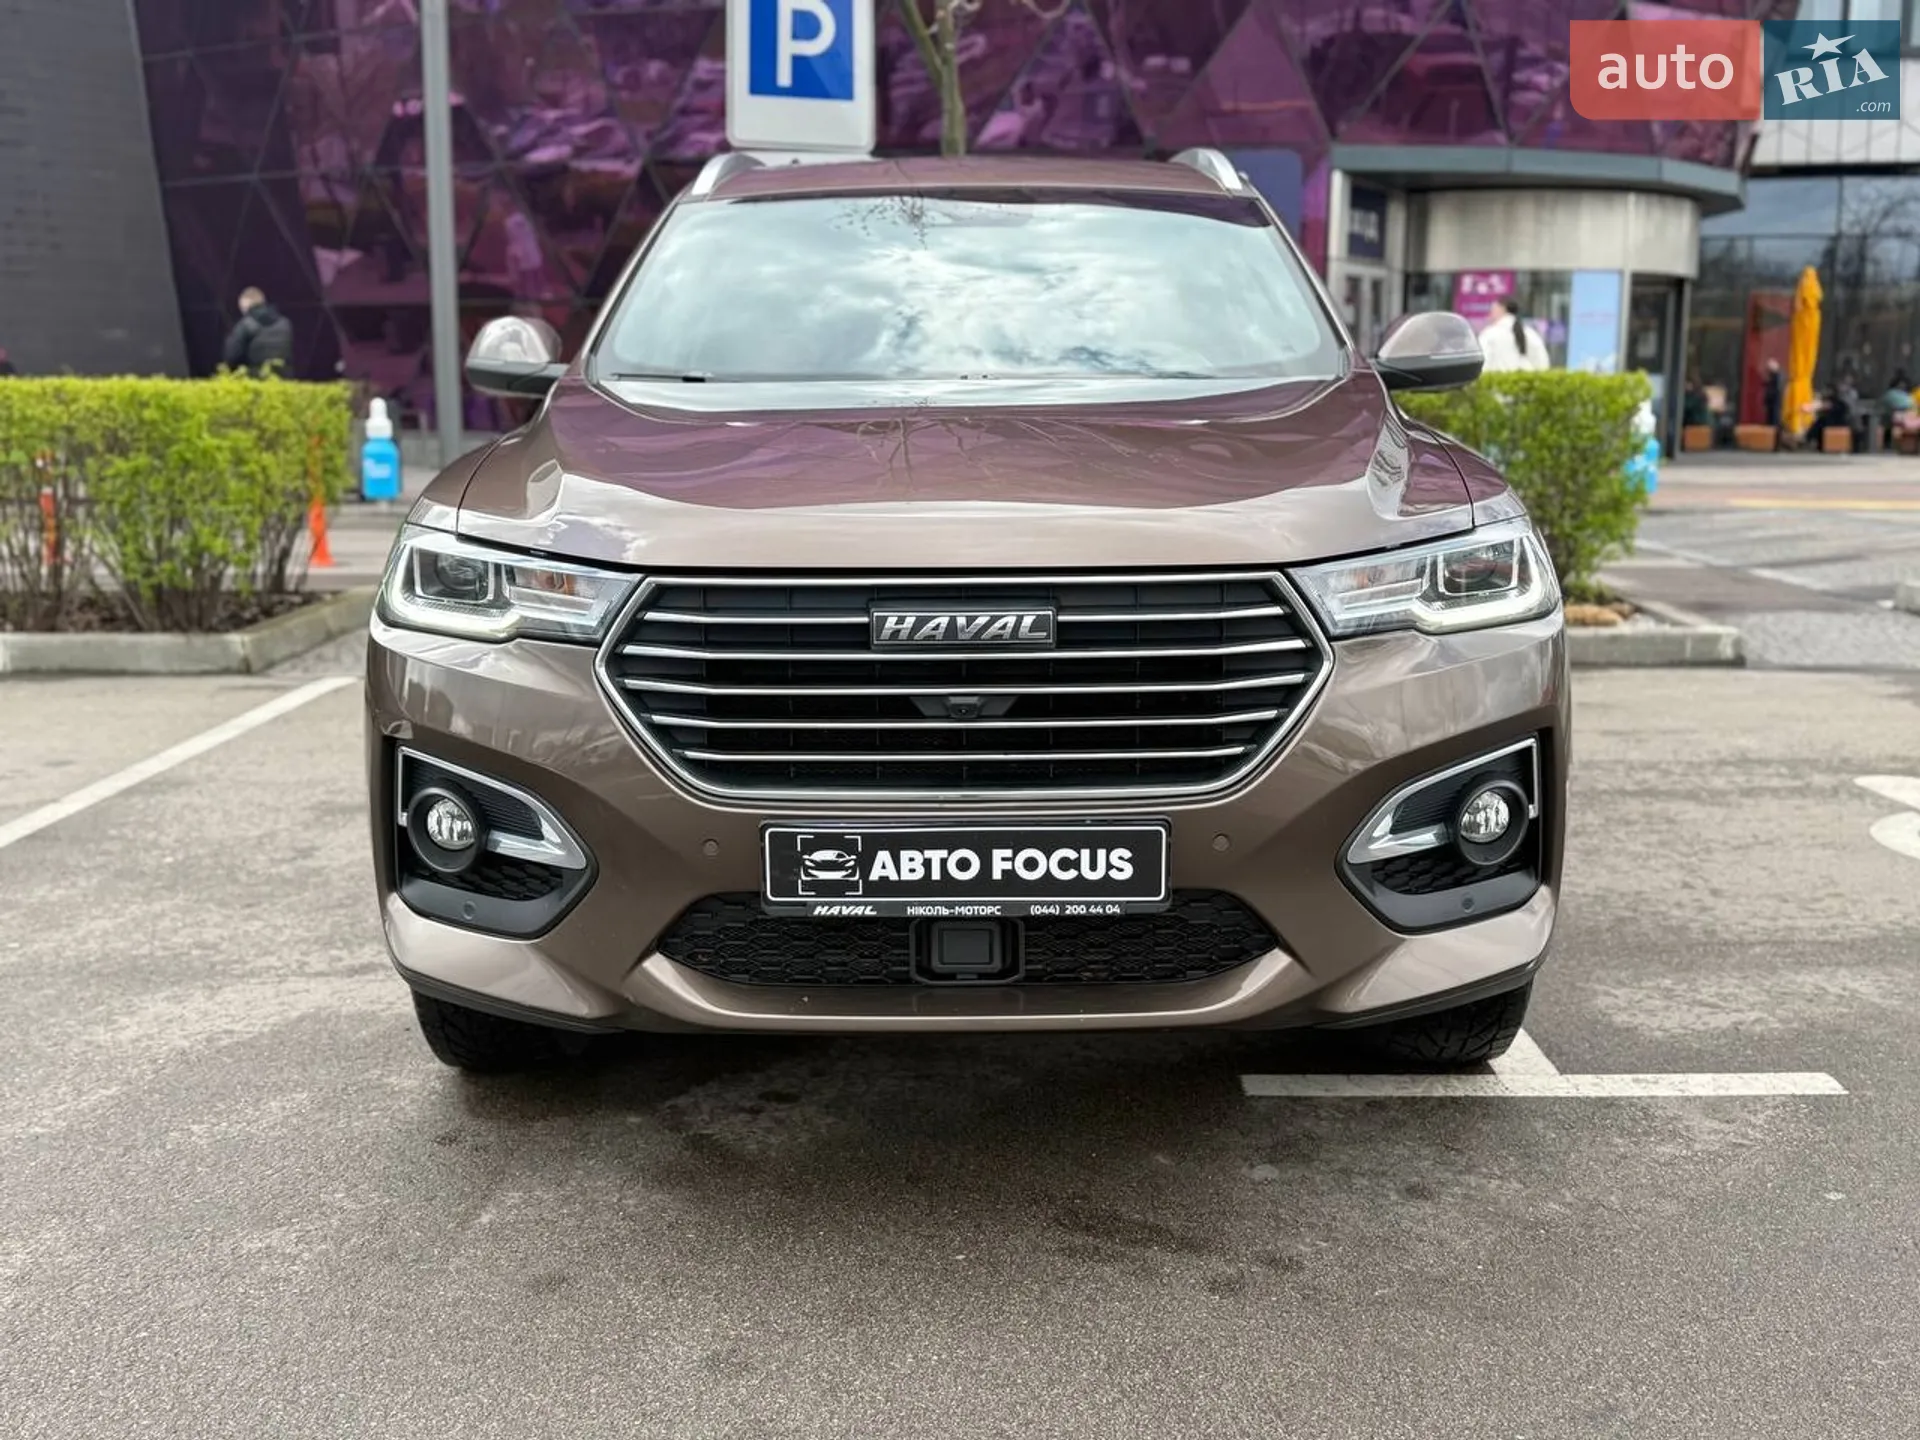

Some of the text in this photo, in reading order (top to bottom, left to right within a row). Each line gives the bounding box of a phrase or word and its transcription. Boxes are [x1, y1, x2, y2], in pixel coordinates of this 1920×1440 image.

[776, 0, 836, 88] P
[879, 615, 1047, 640] HAVAL
[991, 848, 1134, 881] FOCUS
[813, 905, 877, 915] HAVAL
[1030, 904, 1121, 916] (044) 200 44 04
